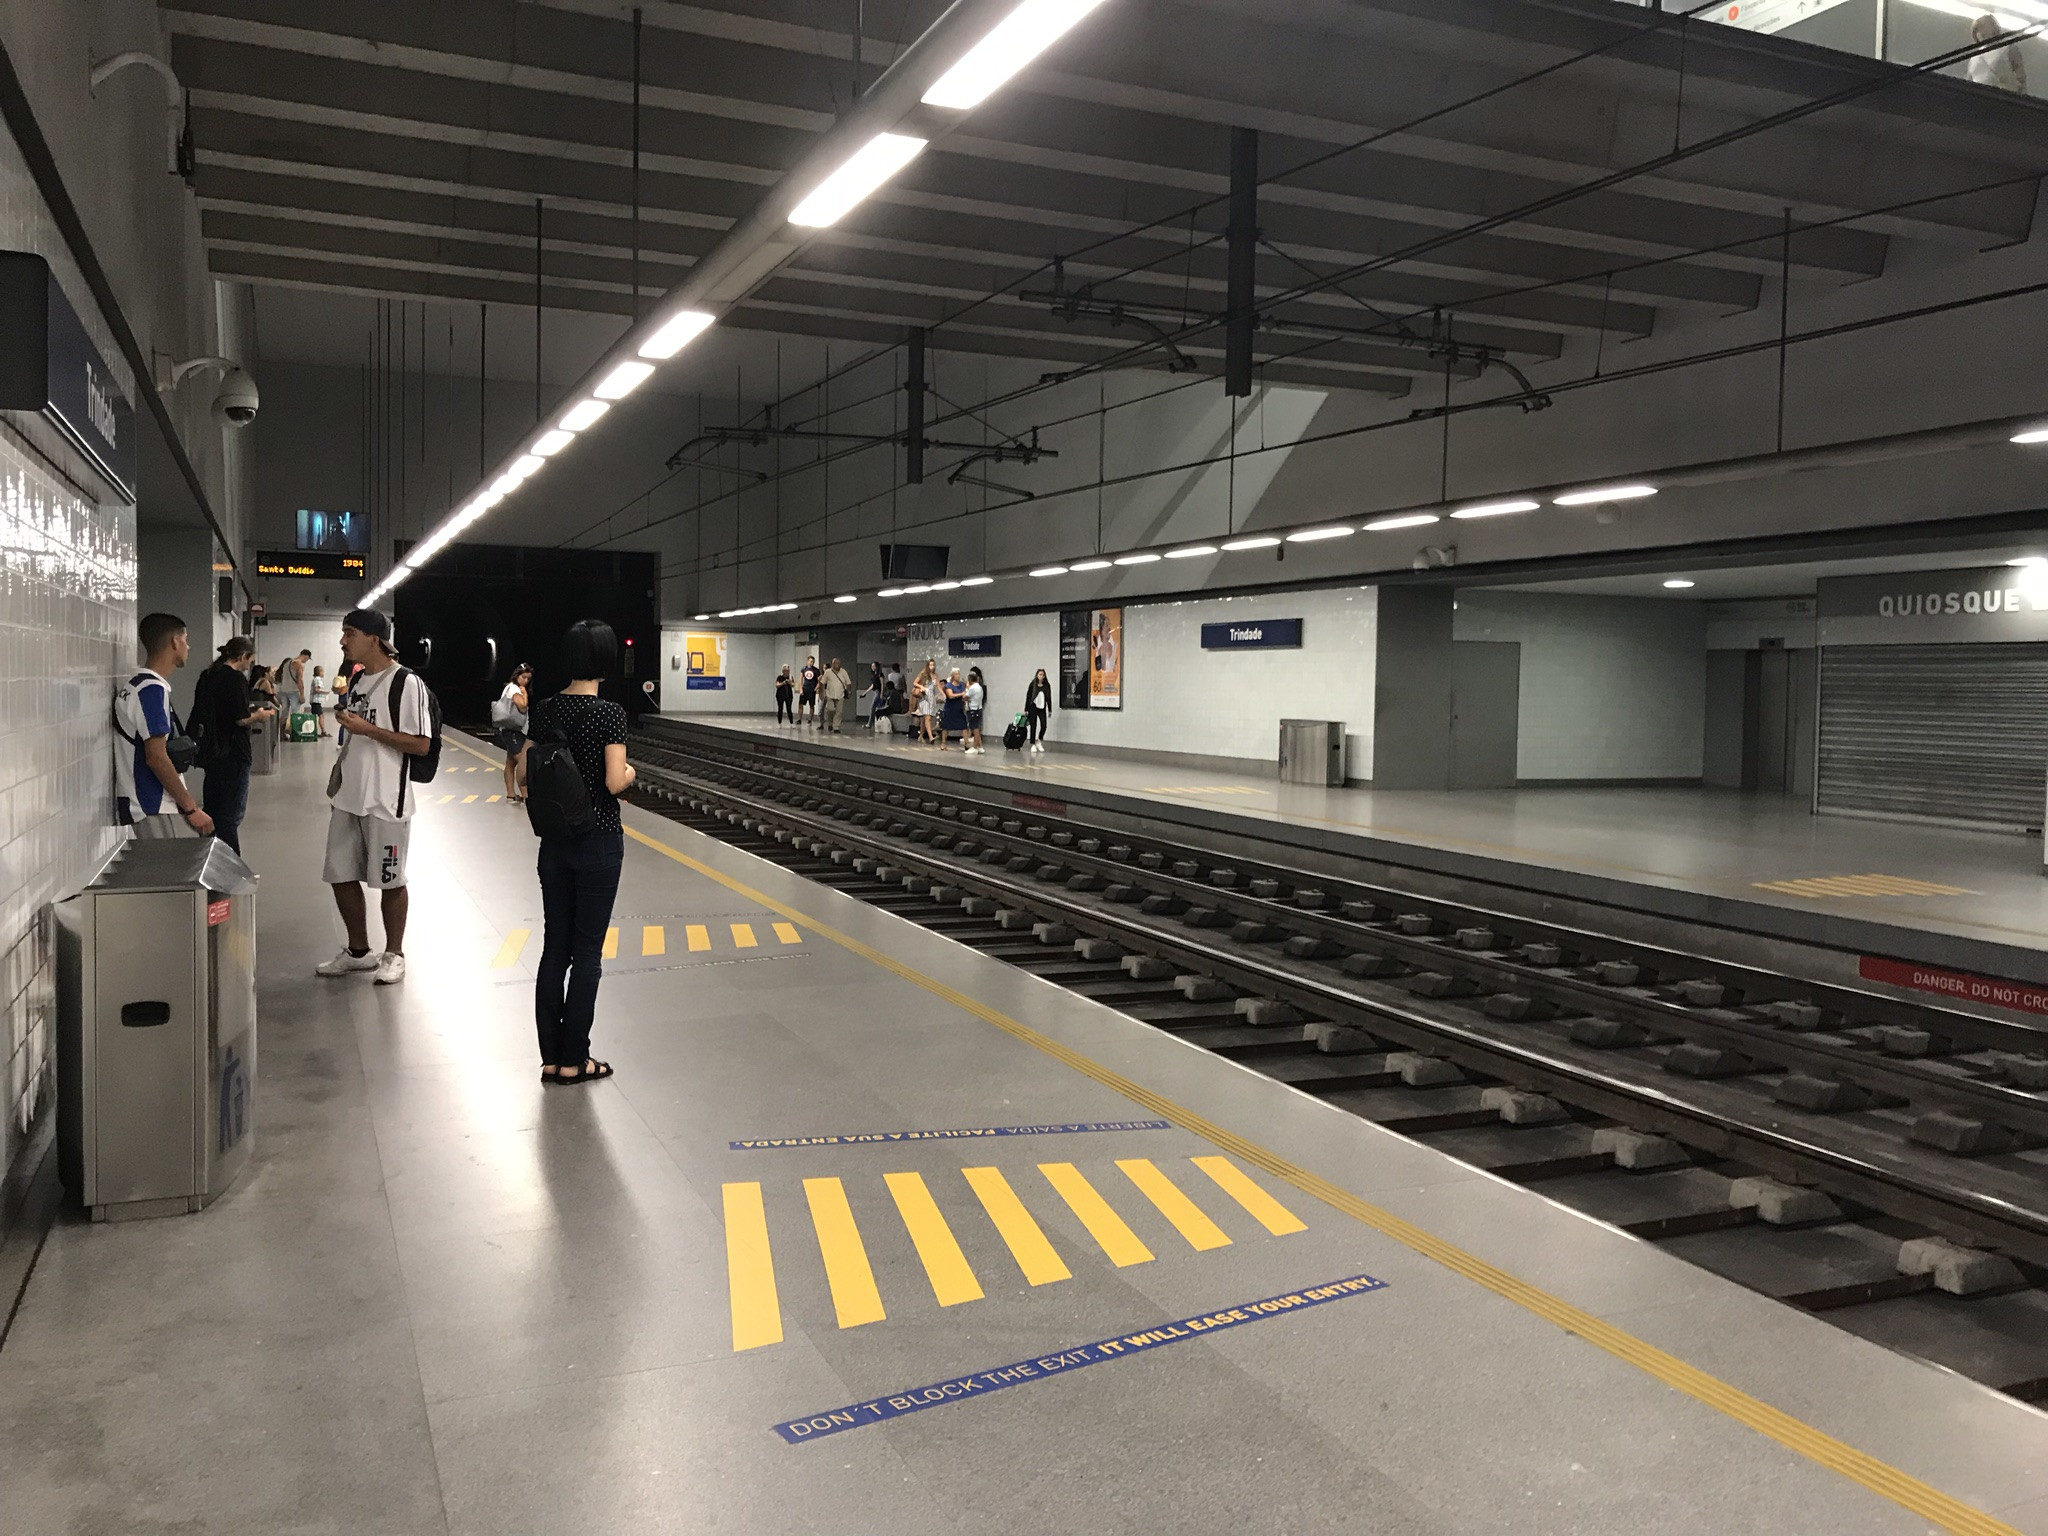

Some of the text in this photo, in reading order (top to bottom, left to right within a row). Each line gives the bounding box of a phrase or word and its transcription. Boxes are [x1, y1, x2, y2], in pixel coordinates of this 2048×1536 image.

[258, 565, 285, 574] Santo
[1879, 588, 2020, 618] QUIOSQUE
[1229, 627, 1263, 641] Trindade
[381, 844, 398, 884] FILA
[1913, 971, 1968, 994] DANGER.
[1971, 983, 1990, 998] DO
[1993, 988, 2020, 1004] NOT
[1086, 1121, 1164, 1131] LIBERTE
[843, 1134, 885, 1142] SUA
[909, 1128, 995, 1139] FACILITE
[735, 1136, 838, 1148] ENTRADA.
[888, 1378, 983, 1411] BLOCK
[980, 1363, 1039, 1386] THE
[1037, 1348, 1100, 1372] EXIT.
[1097, 1340, 1126, 1356] IT
[1124, 1324, 1190, 1348] WILL
[1184, 1308, 1250, 1333] EASE
[1244, 1294, 1310, 1317] YOUR
[1303, 1275, 1381, 1301] ENTRY.
